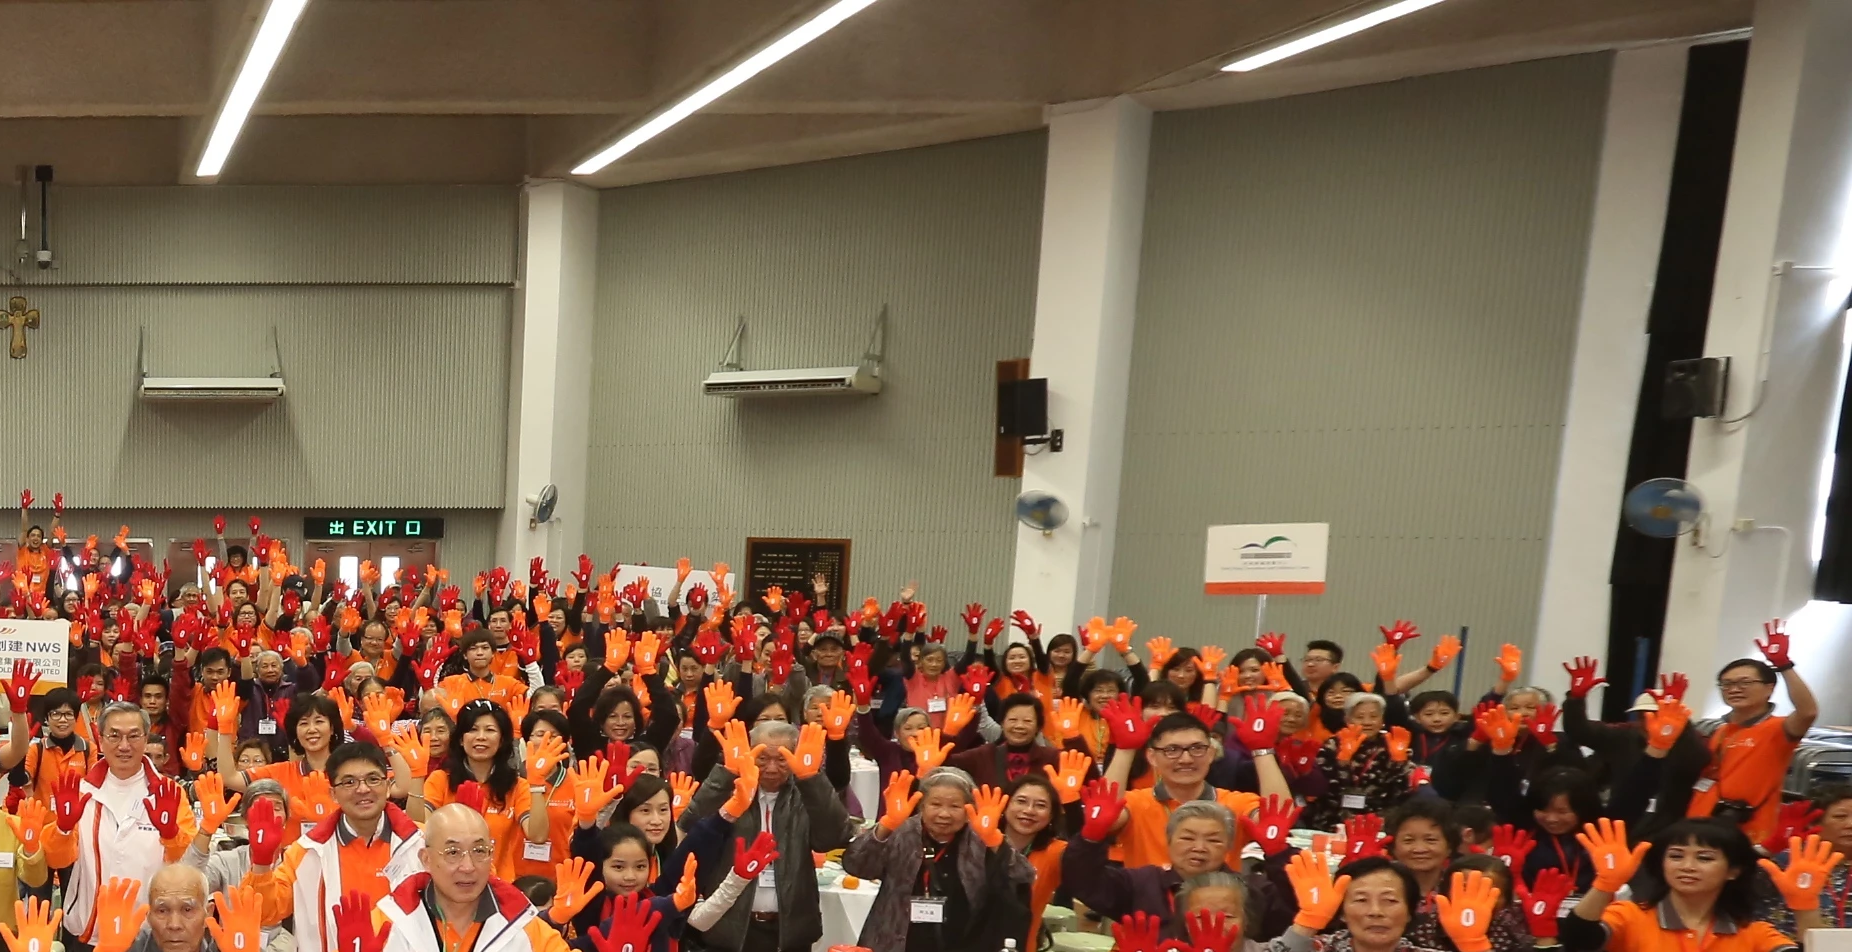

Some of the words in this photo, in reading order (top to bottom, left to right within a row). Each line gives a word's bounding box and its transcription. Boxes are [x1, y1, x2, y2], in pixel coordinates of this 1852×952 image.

[329, 520, 344, 535] 出
[353, 520, 397, 536] EXIT
[405, 520, 421, 535] 口
[26, 641, 62, 654] NWS
[645, 652, 650, 662] 0
[18, 687, 24, 697] 0
[717, 703, 722, 713] 1
[379, 720, 387, 730] 0
[1126, 720, 1134, 731] 1
[1253, 719, 1264, 731] 0
[410, 749, 418, 759] 1
[733, 747, 738, 758] 1
[924, 750, 929, 760] 1
[536, 758, 545, 768] 0
[804, 754, 811, 766] 0
[611, 775, 618, 791] 1
[1067, 776, 1076, 787] 0
[584, 788, 590, 802] 1
[673, 795, 682, 806] 0
[65, 802, 69, 815] 1
[209, 801, 217, 815] 1
[316, 804, 323, 814] 0
[896, 799, 901, 810] 1
[161, 811, 168, 824] 0
[1092, 807, 1100, 818] 1
[982, 816, 989, 827] 0
[26, 829, 33, 840] 0
[257, 829, 263, 843] 1
[1267, 826, 1277, 839] 0
[1354, 842, 1363, 853] 1
[747, 861, 758, 872] 0
[1605, 854, 1614, 869] 1
[1310, 887, 1318, 903] 1
[1533, 901, 1545, 914] 0
[1461, 909, 1474, 926] 0
[114, 917, 120, 934] 1
[235, 932, 244, 949] 0
